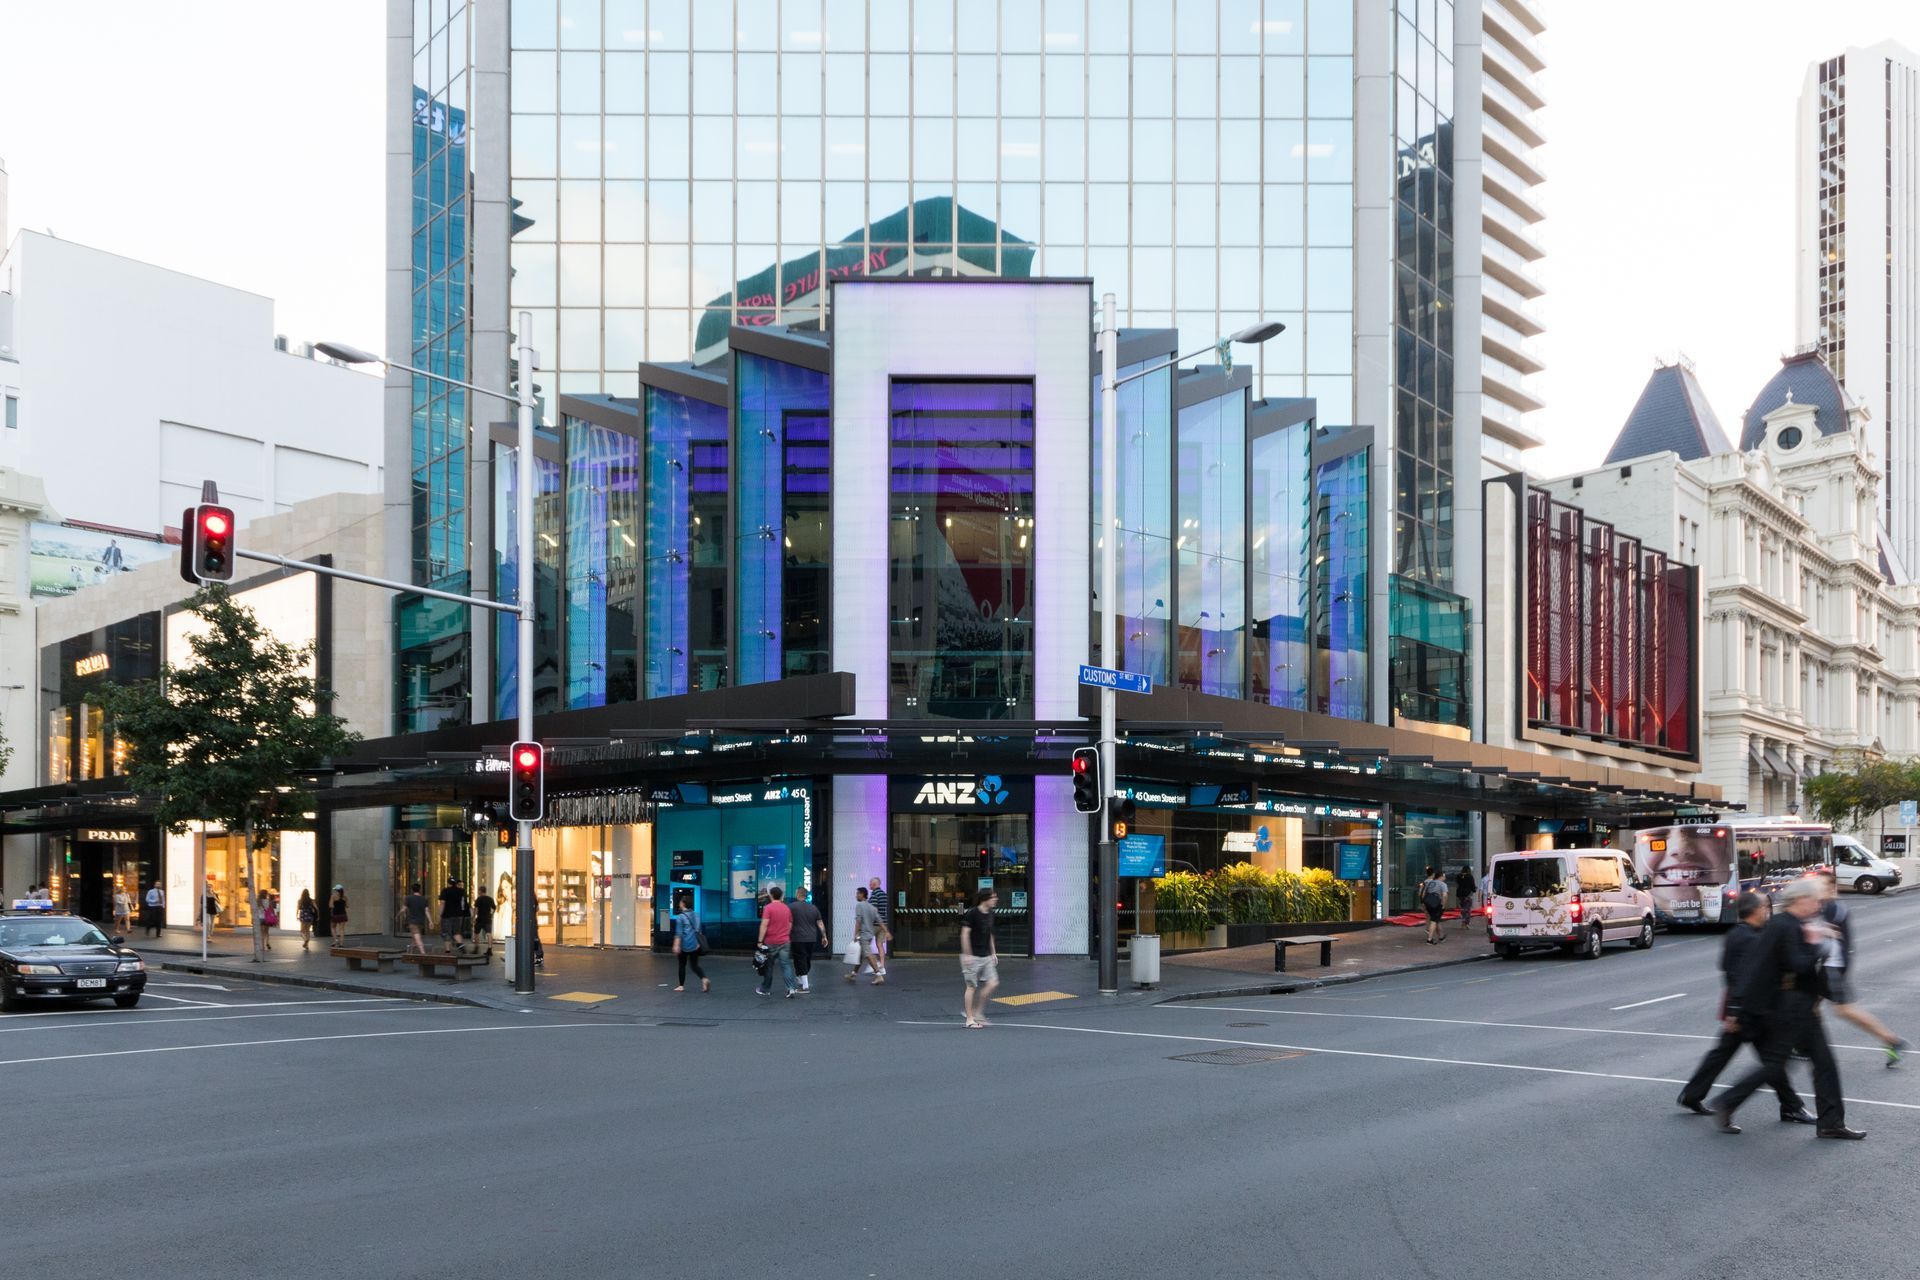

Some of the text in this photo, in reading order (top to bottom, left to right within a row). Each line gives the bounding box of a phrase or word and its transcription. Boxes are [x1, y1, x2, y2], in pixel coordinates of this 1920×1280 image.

[1083, 668, 1117, 686] CUSTOMS
[651, 790, 670, 799] ANZ
[735, 792, 752, 802] Street
[764, 790, 781, 800] ANZ
[791, 789, 800, 798] 45
[913, 782, 976, 804] ANZ
[1135, 791, 1143, 799] 45
[1144, 792, 1161, 803] Queen
[1161, 793, 1177, 804] Street
[1220, 793, 1240, 802] ANZ
[1280, 804, 1294, 813] Queen
[1681, 816, 1714, 825] TOUS
[88, 830, 137, 841] PRADA
[804, 821, 812, 848] Street
[1670, 900, 1690, 908] Must
[1690, 899, 1700, 908] be
